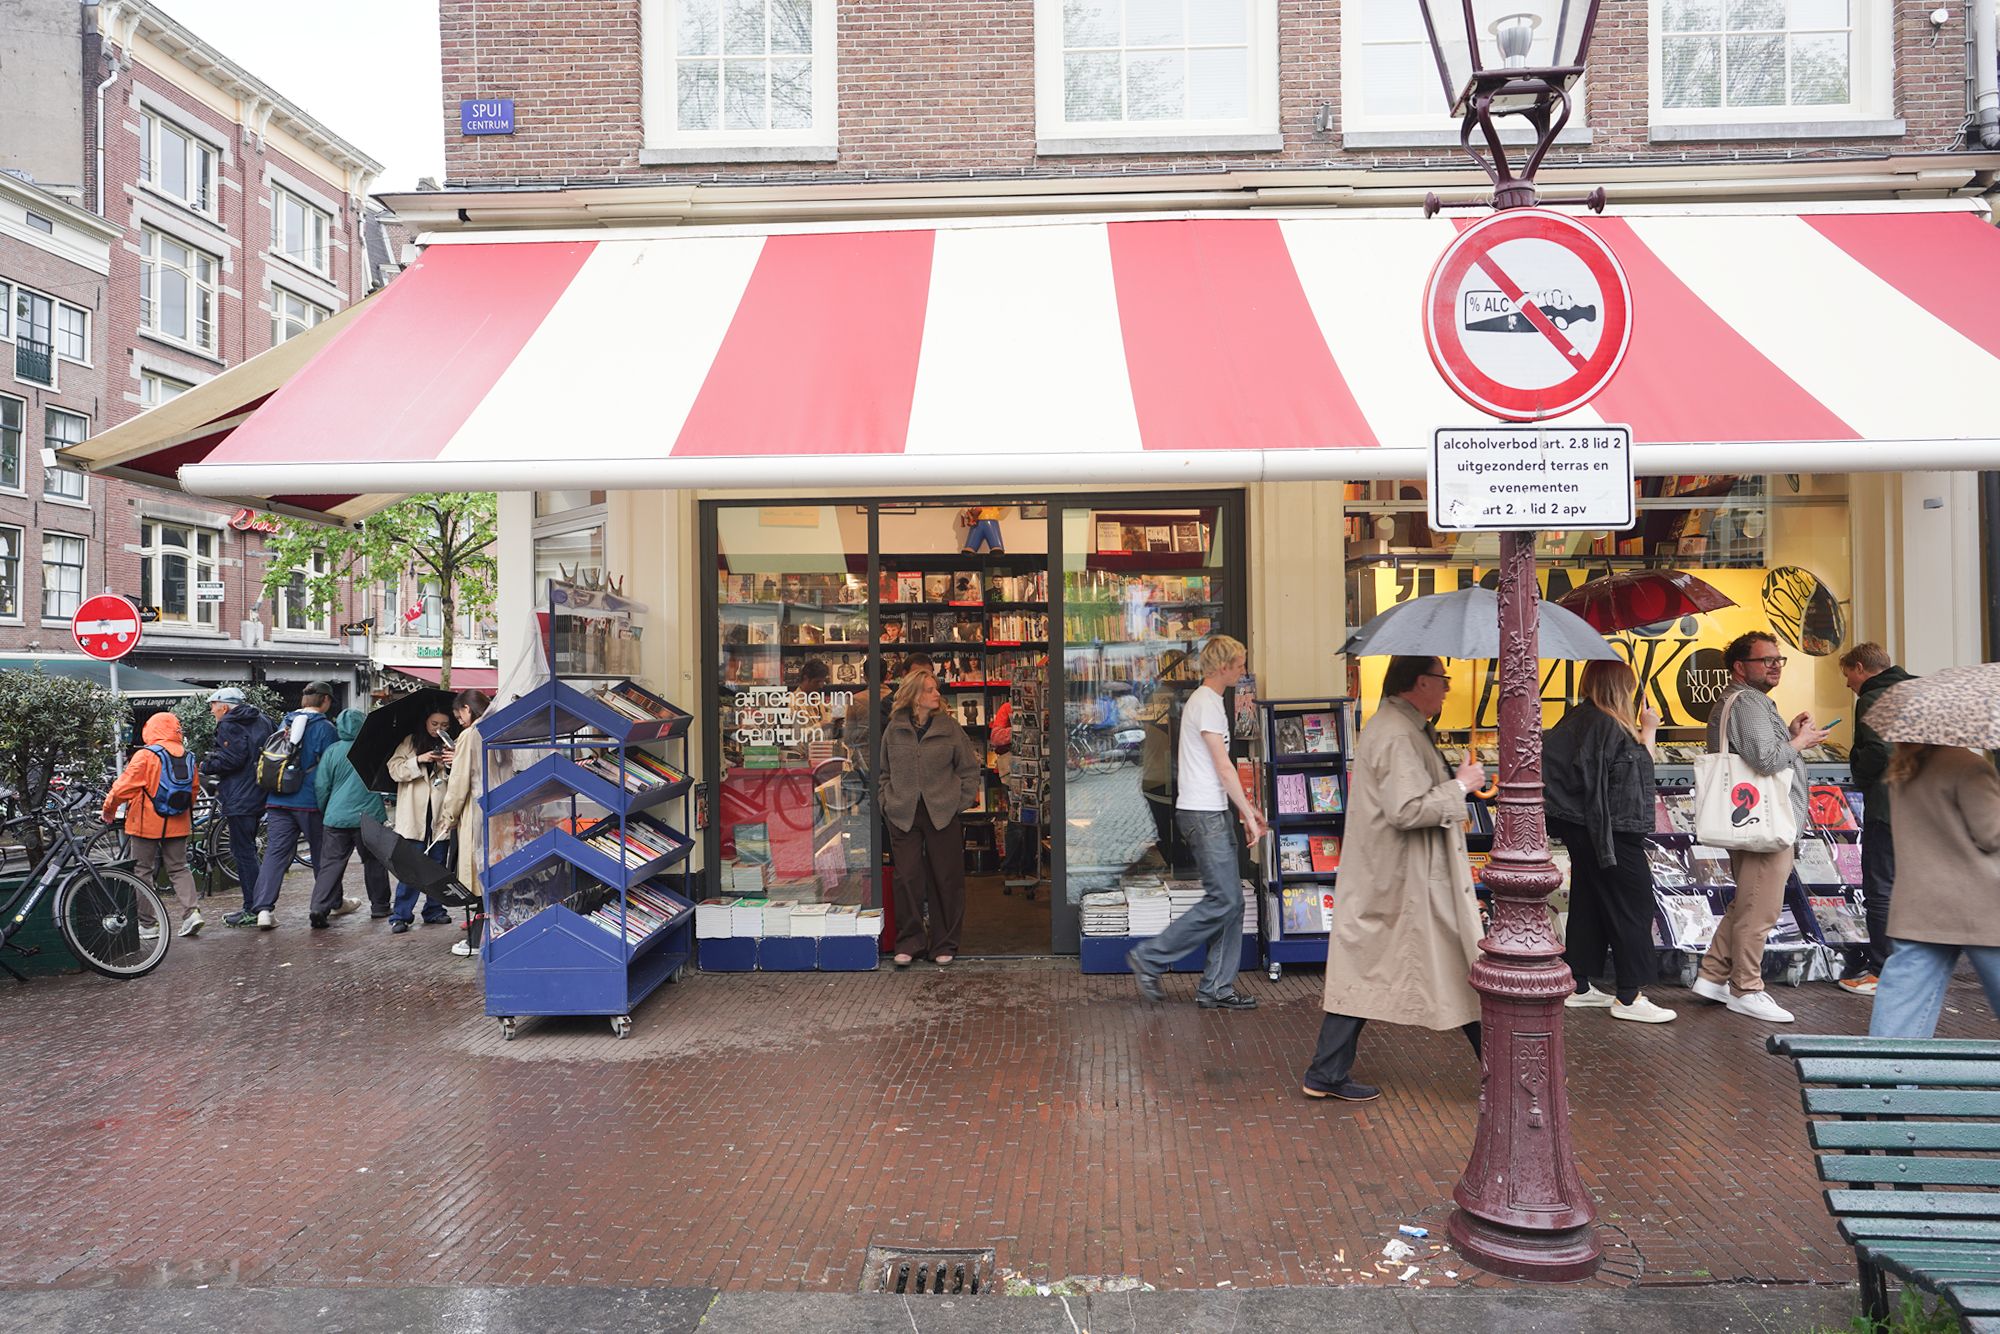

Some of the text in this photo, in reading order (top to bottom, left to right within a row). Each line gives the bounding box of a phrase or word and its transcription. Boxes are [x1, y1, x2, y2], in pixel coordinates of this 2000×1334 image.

[472, 103, 502, 118] SPUI
[467, 120, 509, 130] CENTRUM
[1484, 297, 1510, 312] ALC
[1443, 437, 1622, 449] alcoholverbod art. 2.8 lid 2
[1457, 459, 1609, 475] uitgezonderd terras en
[1489, 482, 1579, 493] evenementen
[1482, 503, 1501, 515] art
[1530, 503, 1546, 515] lid
[1551, 503, 1559, 514] 2
[1563, 505, 1587, 517] apv
[1686, 669, 1710, 687] NU
[735, 686, 854, 707] athenaeum
[1690, 685, 1724, 703] KOO
[132, 698, 147, 707] Café
[147, 699, 164, 707] Lange
[165, 698, 177, 706] Leo
[735, 725, 824, 744] centrum
